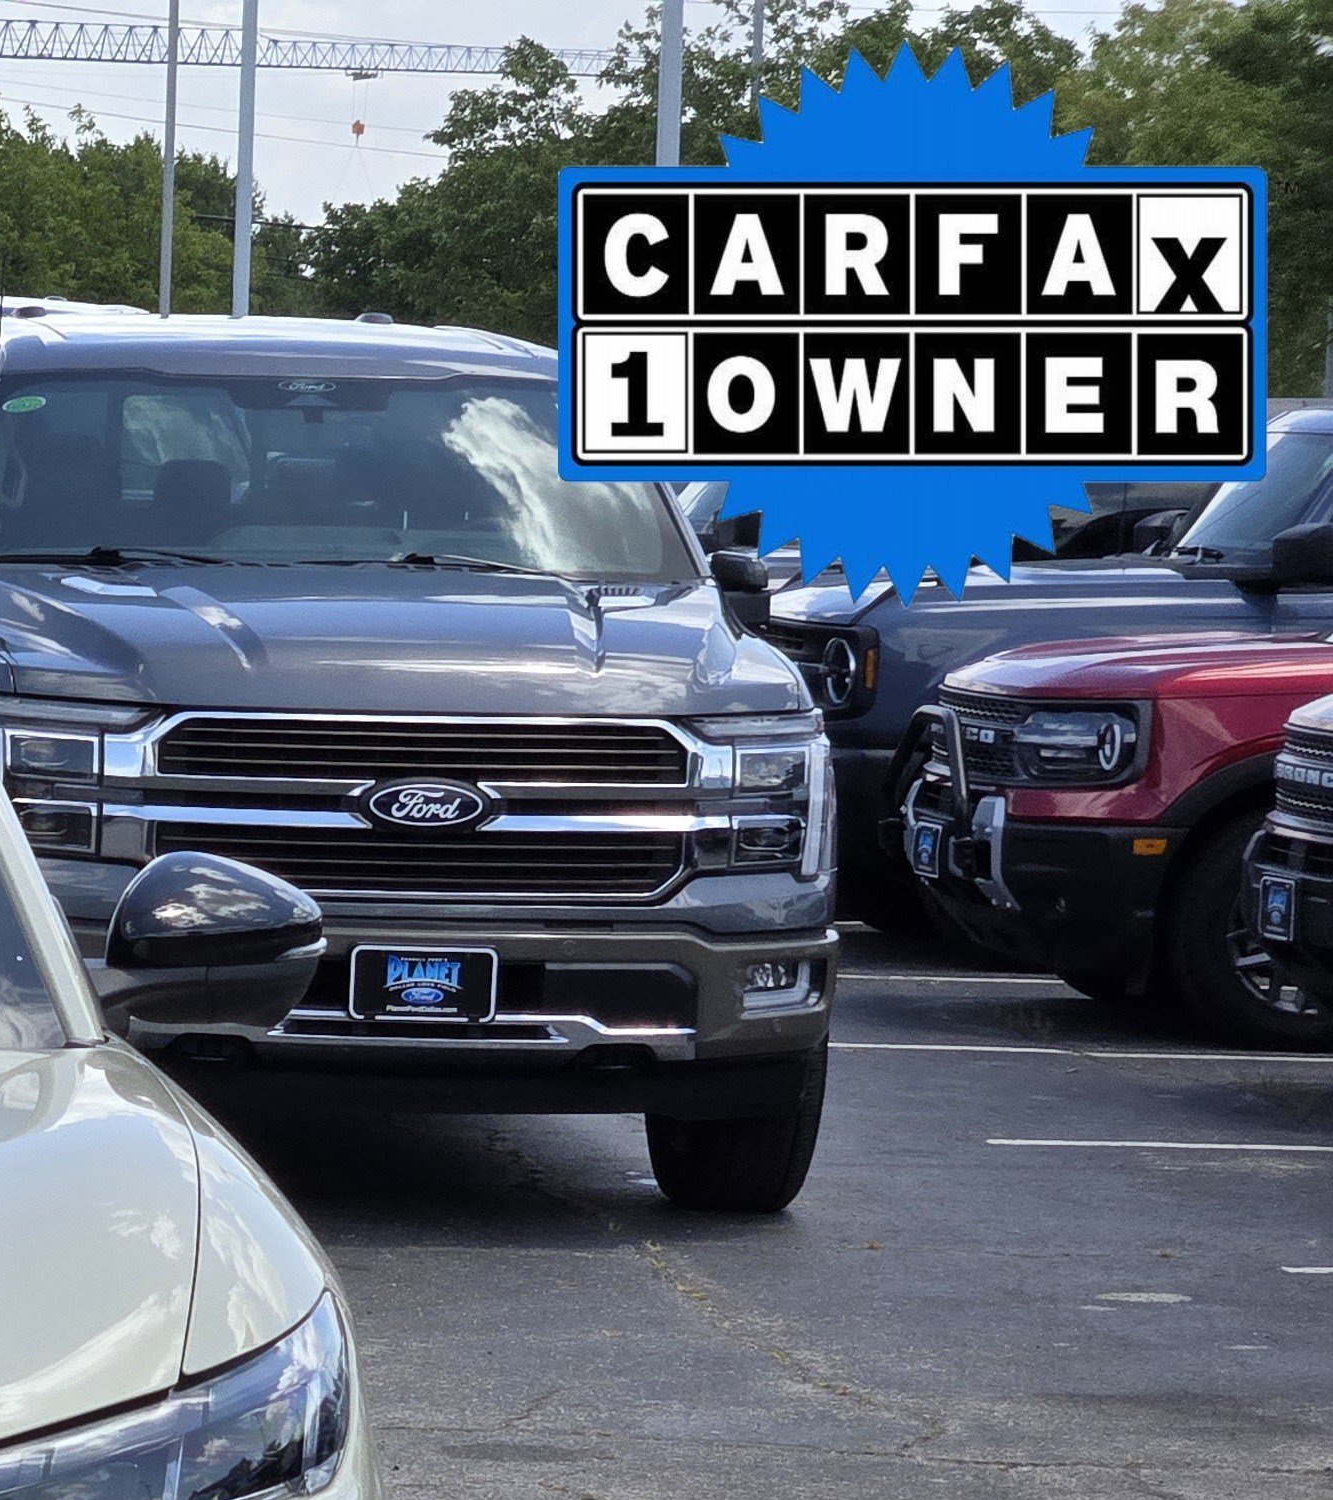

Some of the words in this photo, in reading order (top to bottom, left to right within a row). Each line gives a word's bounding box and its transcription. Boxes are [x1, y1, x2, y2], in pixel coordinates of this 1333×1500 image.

[1276, 762, 1333, 788] BRONC
[391, 789, 462, 819] Ford
[386, 954, 461, 987] PLANET
